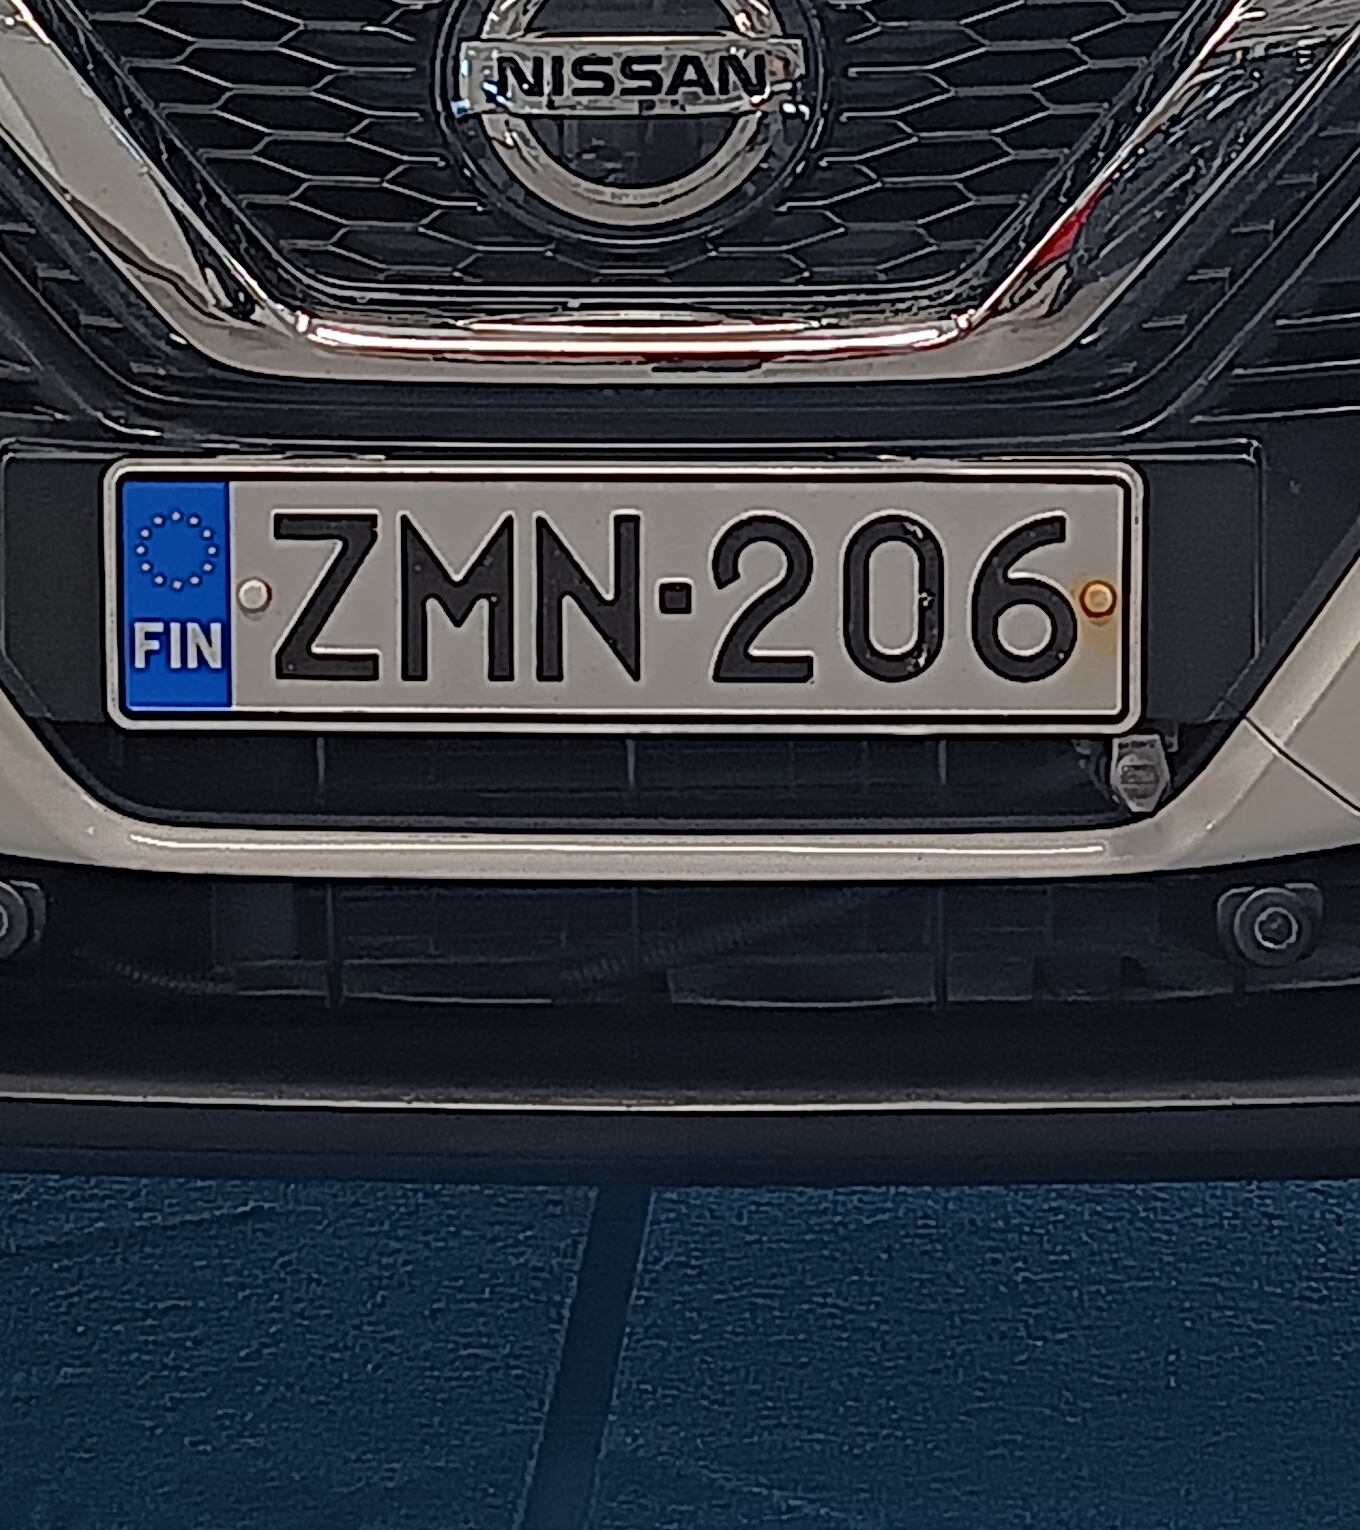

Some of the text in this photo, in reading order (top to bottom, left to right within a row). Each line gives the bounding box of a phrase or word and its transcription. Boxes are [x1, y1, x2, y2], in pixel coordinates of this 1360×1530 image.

[495, 53, 767, 97] NISSAN
[272, 511, 1078, 684] ZMN-206
[133, 621, 223, 670] FIN
